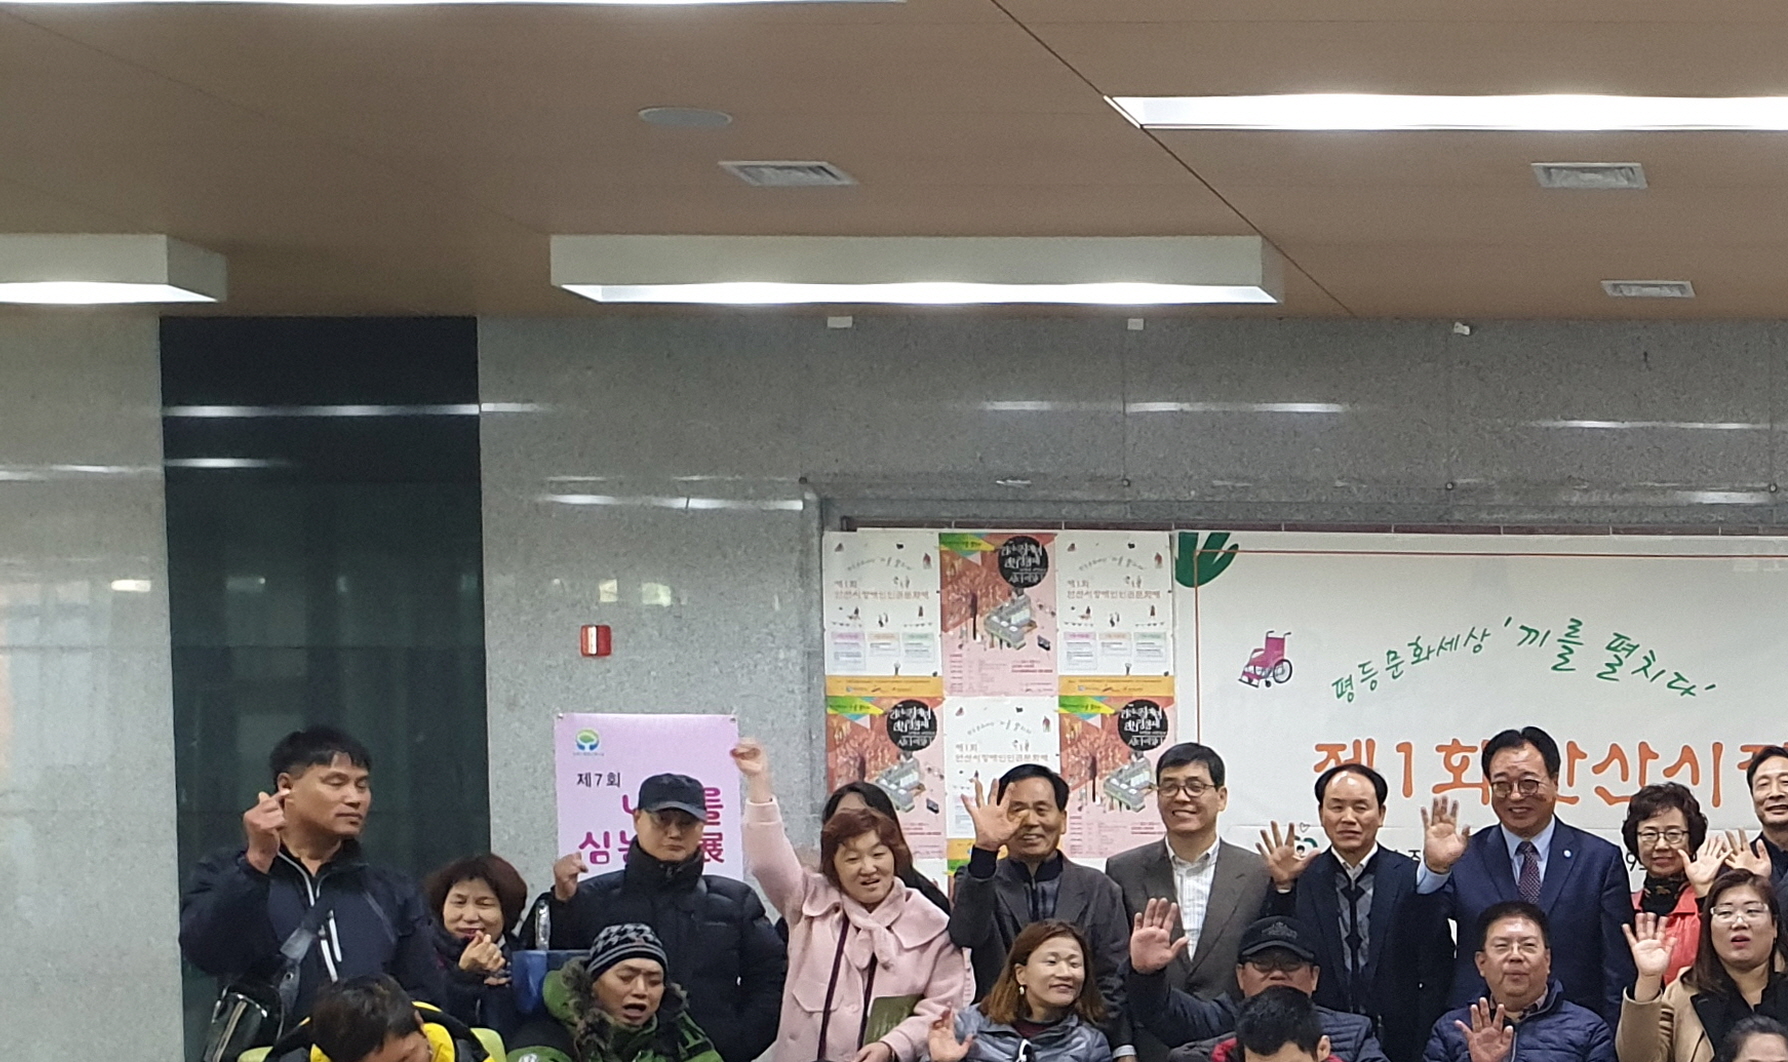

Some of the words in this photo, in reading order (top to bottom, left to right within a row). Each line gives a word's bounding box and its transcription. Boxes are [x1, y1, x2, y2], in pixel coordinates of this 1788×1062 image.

[1331, 625, 1492, 703] 평등문화세상
[576, 771, 621, 788] 제7회
[1313, 738, 1491, 807] 제1회
